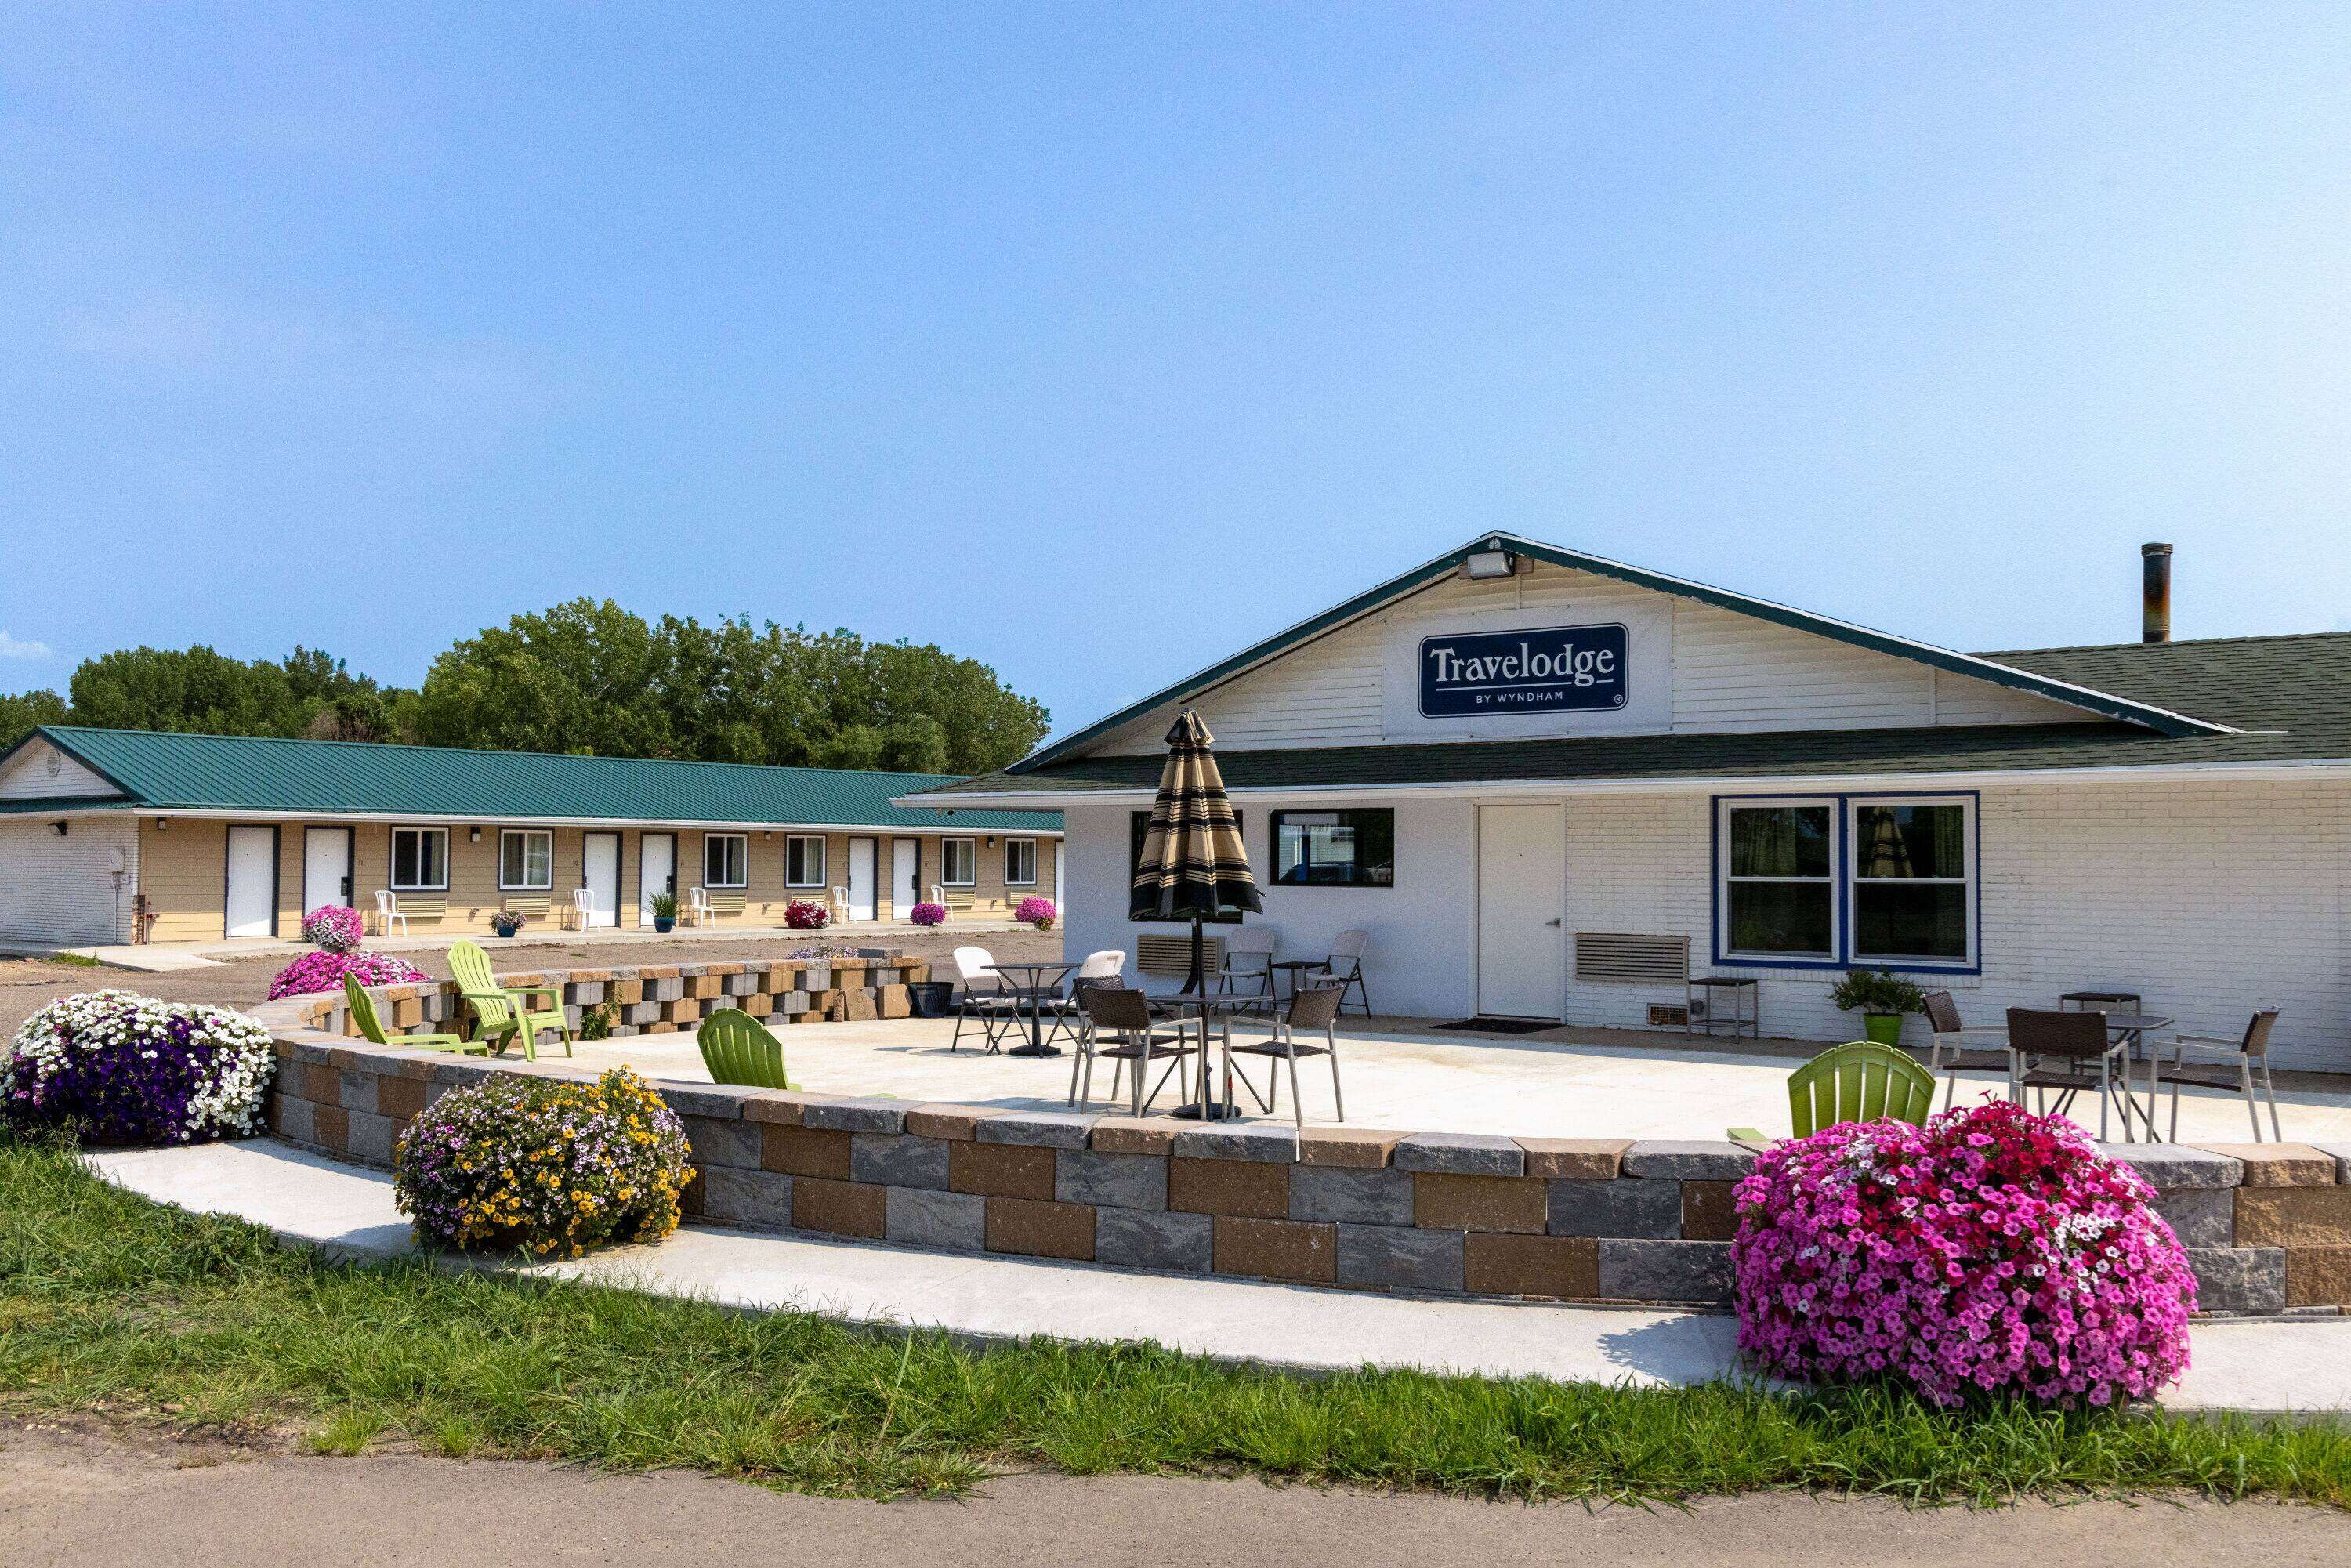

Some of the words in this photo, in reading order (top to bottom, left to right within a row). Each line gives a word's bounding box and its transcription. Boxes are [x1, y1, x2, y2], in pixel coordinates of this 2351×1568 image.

[1429, 642, 1615, 687] Travelodge
[1476, 695, 1491, 704] BY
[1497, 691, 1563, 703] WYNDHAM
